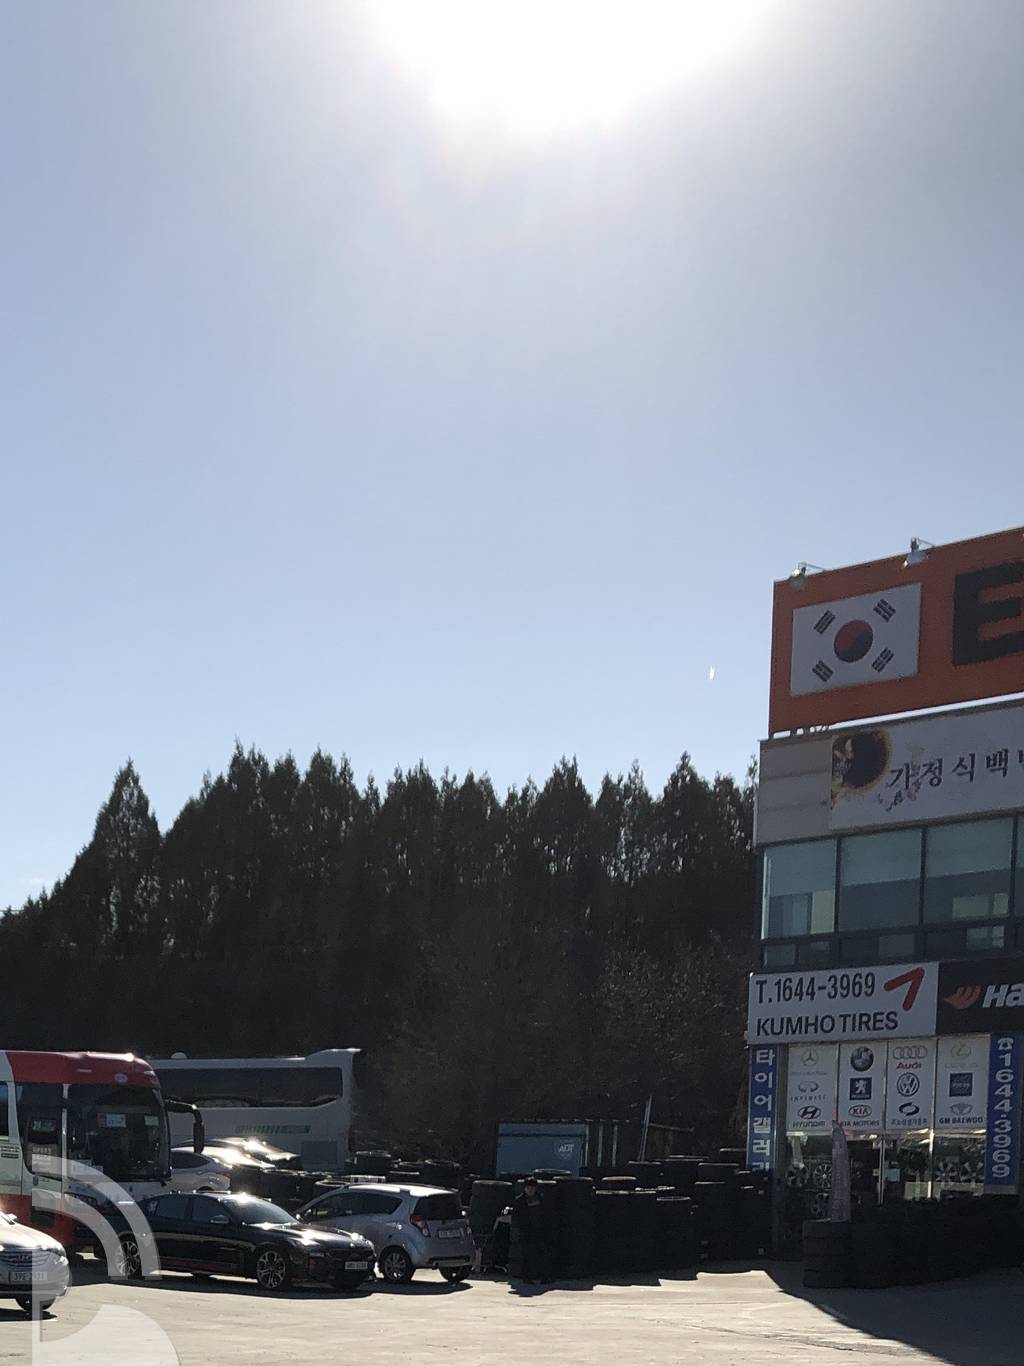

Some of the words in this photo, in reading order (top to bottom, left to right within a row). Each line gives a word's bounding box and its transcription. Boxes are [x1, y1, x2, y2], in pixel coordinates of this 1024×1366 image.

[756, 972, 876, 1004] T.1644-3969
[756, 1014, 836, 1037] KUMHO
[839, 1011, 899, 1033] TIRES
[896, 1062, 922, 1070] Audi
